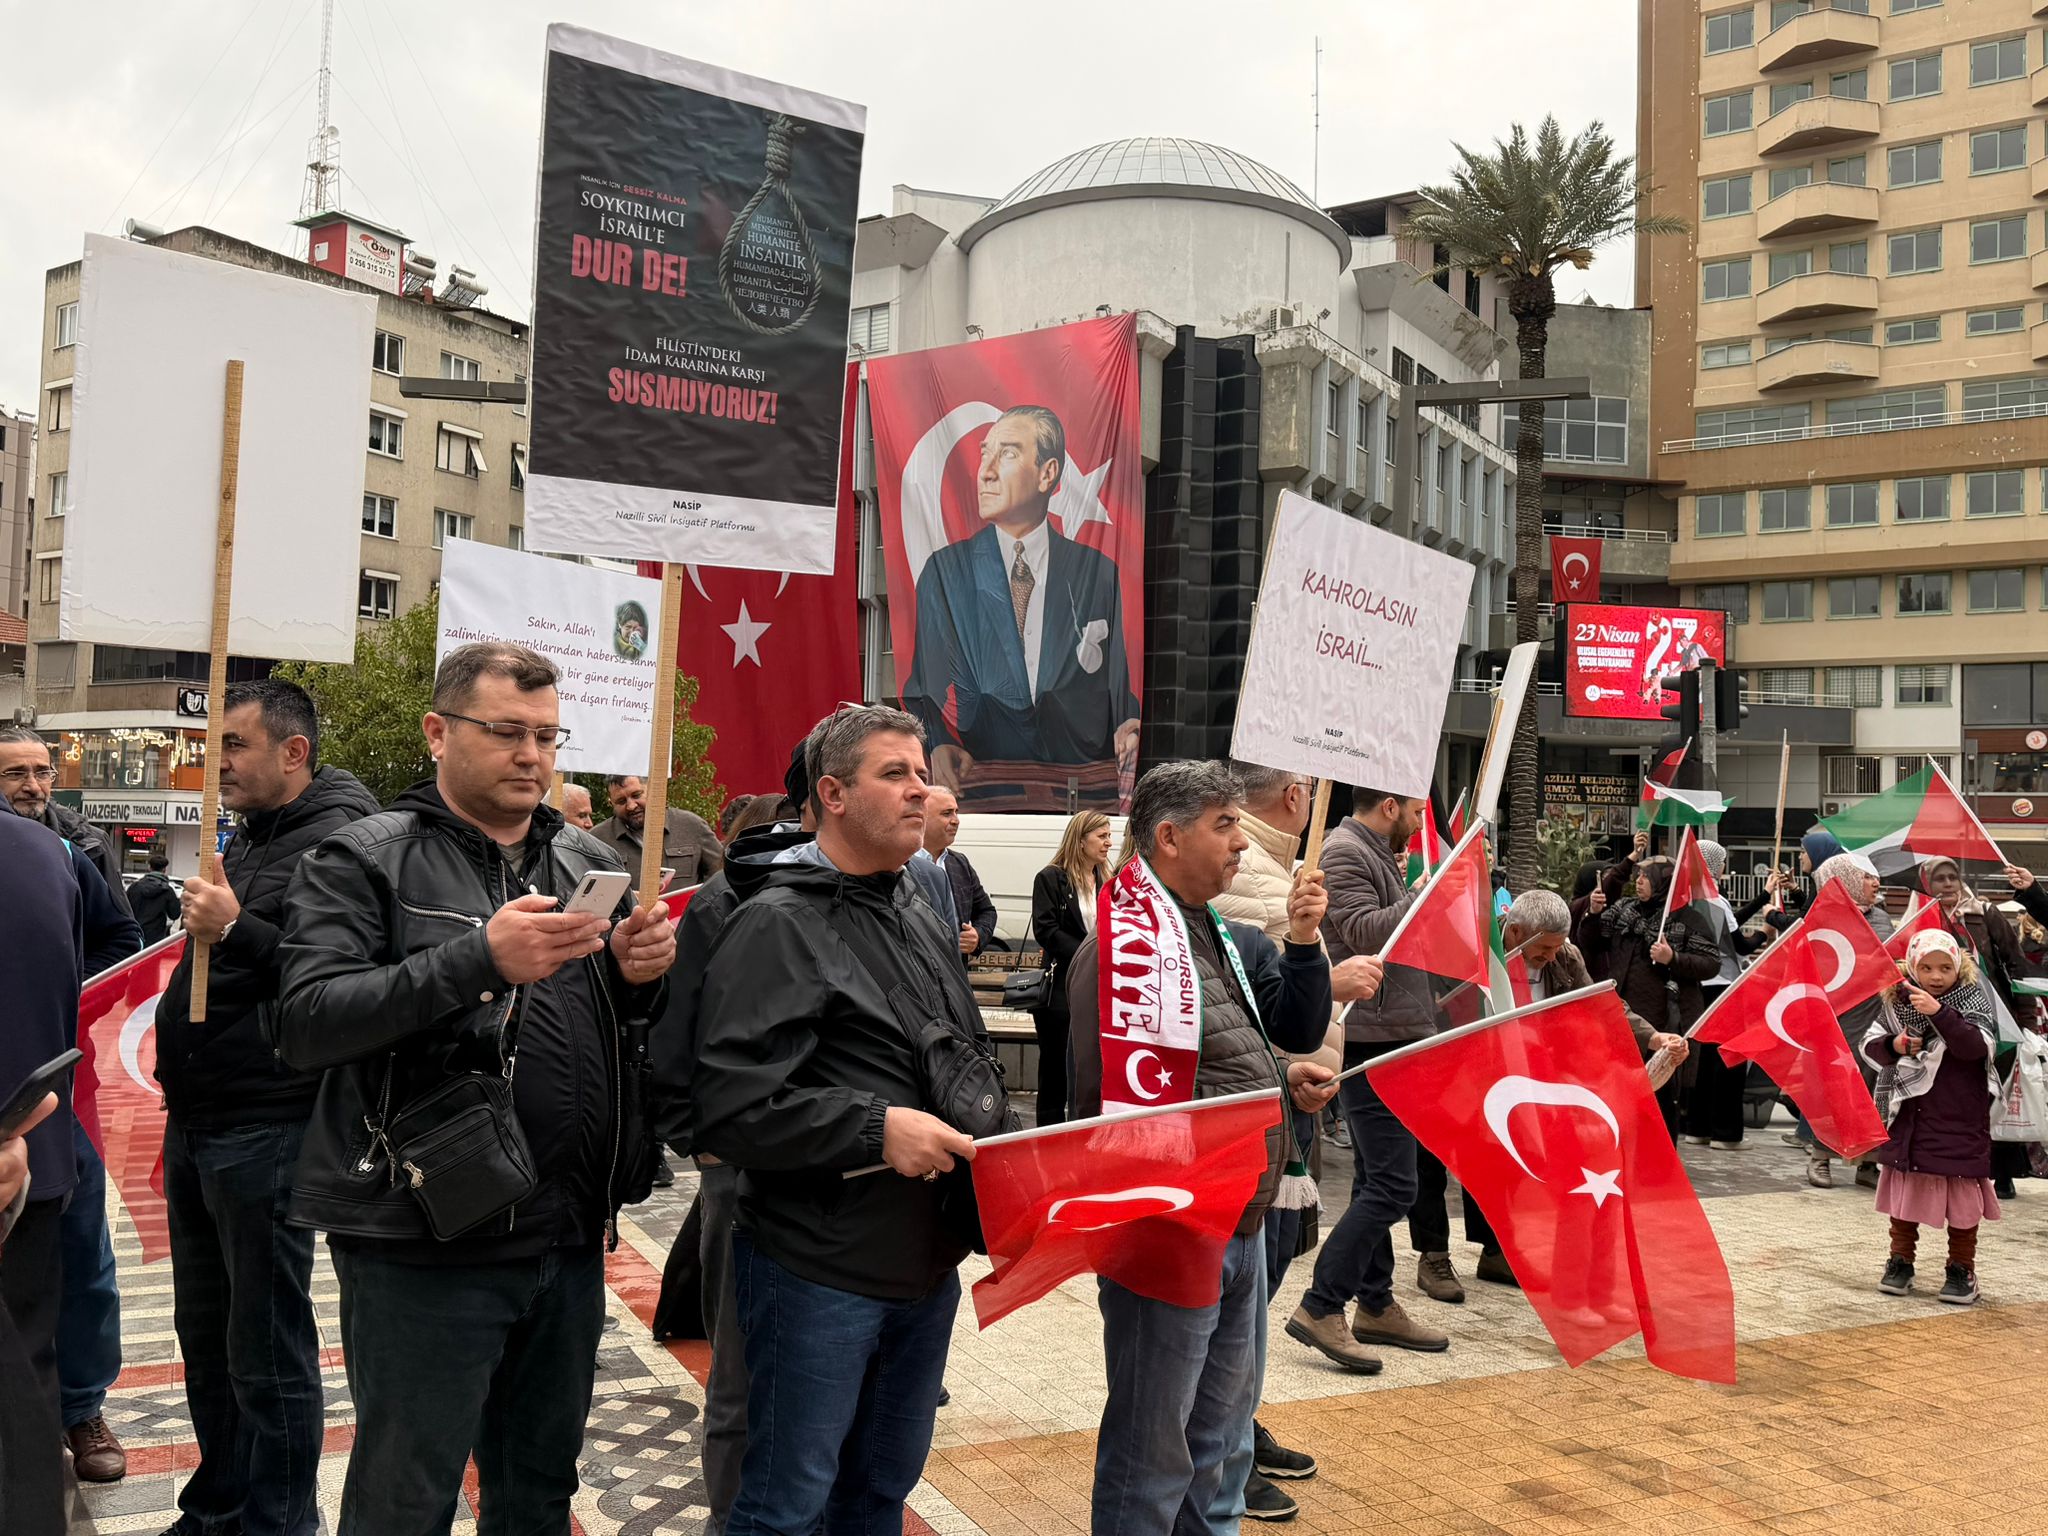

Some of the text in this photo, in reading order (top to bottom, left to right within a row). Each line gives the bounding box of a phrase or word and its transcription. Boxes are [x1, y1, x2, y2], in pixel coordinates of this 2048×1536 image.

[623, 184, 655, 198] SESSİZ
[656, 191, 688, 206] KALMA
[580, 190, 686, 228] SOYKIRIMCI
[600, 213, 665, 244] İSRAİL'E
[751, 222, 798, 240] MENSCHHEIT
[756, 215, 794, 229] HUMANITY
[747, 231, 801, 253] HUMANITÉ
[571, 233, 689, 298] DUR DE!
[740, 240, 807, 271] İNSANLIK
[733, 260, 780, 277] HUMANIDAD
[733, 273, 772, 290] UMANITÀ
[735, 287, 805, 309] ЧЕЛОВЕЧЕСТВО
[655, 336, 741, 363] FİLİSTİN'DEKİ
[625, 346, 766, 384] İDAM KARARINA KARŞI
[608, 367, 778, 425] SUSMUYORUZ!
[672, 499, 701, 511] NASİP
[615, 510, 645, 522] Nazilli
[648, 512, 667, 525] Sivil
[710, 518, 756, 532] Platformu
[1301, 568, 1418, 628] KAHROLASIN
[444, 626, 501, 643] zalimlerin
[527, 616, 560, 633] Sakın,
[1574, 623, 1641, 644] 23 Nisan
[1316, 624, 1383, 671] İSRAİL...
[567, 666, 582, 679] bir
[584, 672, 609, 685] güne
[580, 692, 608, 707] dışarı
[1324, 727, 1344, 738] NASİP
[84, 804, 130, 822] NAZGENÇ
[133, 803, 163, 816] TEKNOLOJİ
[1177, 943, 1195, 1020] DURSUN
